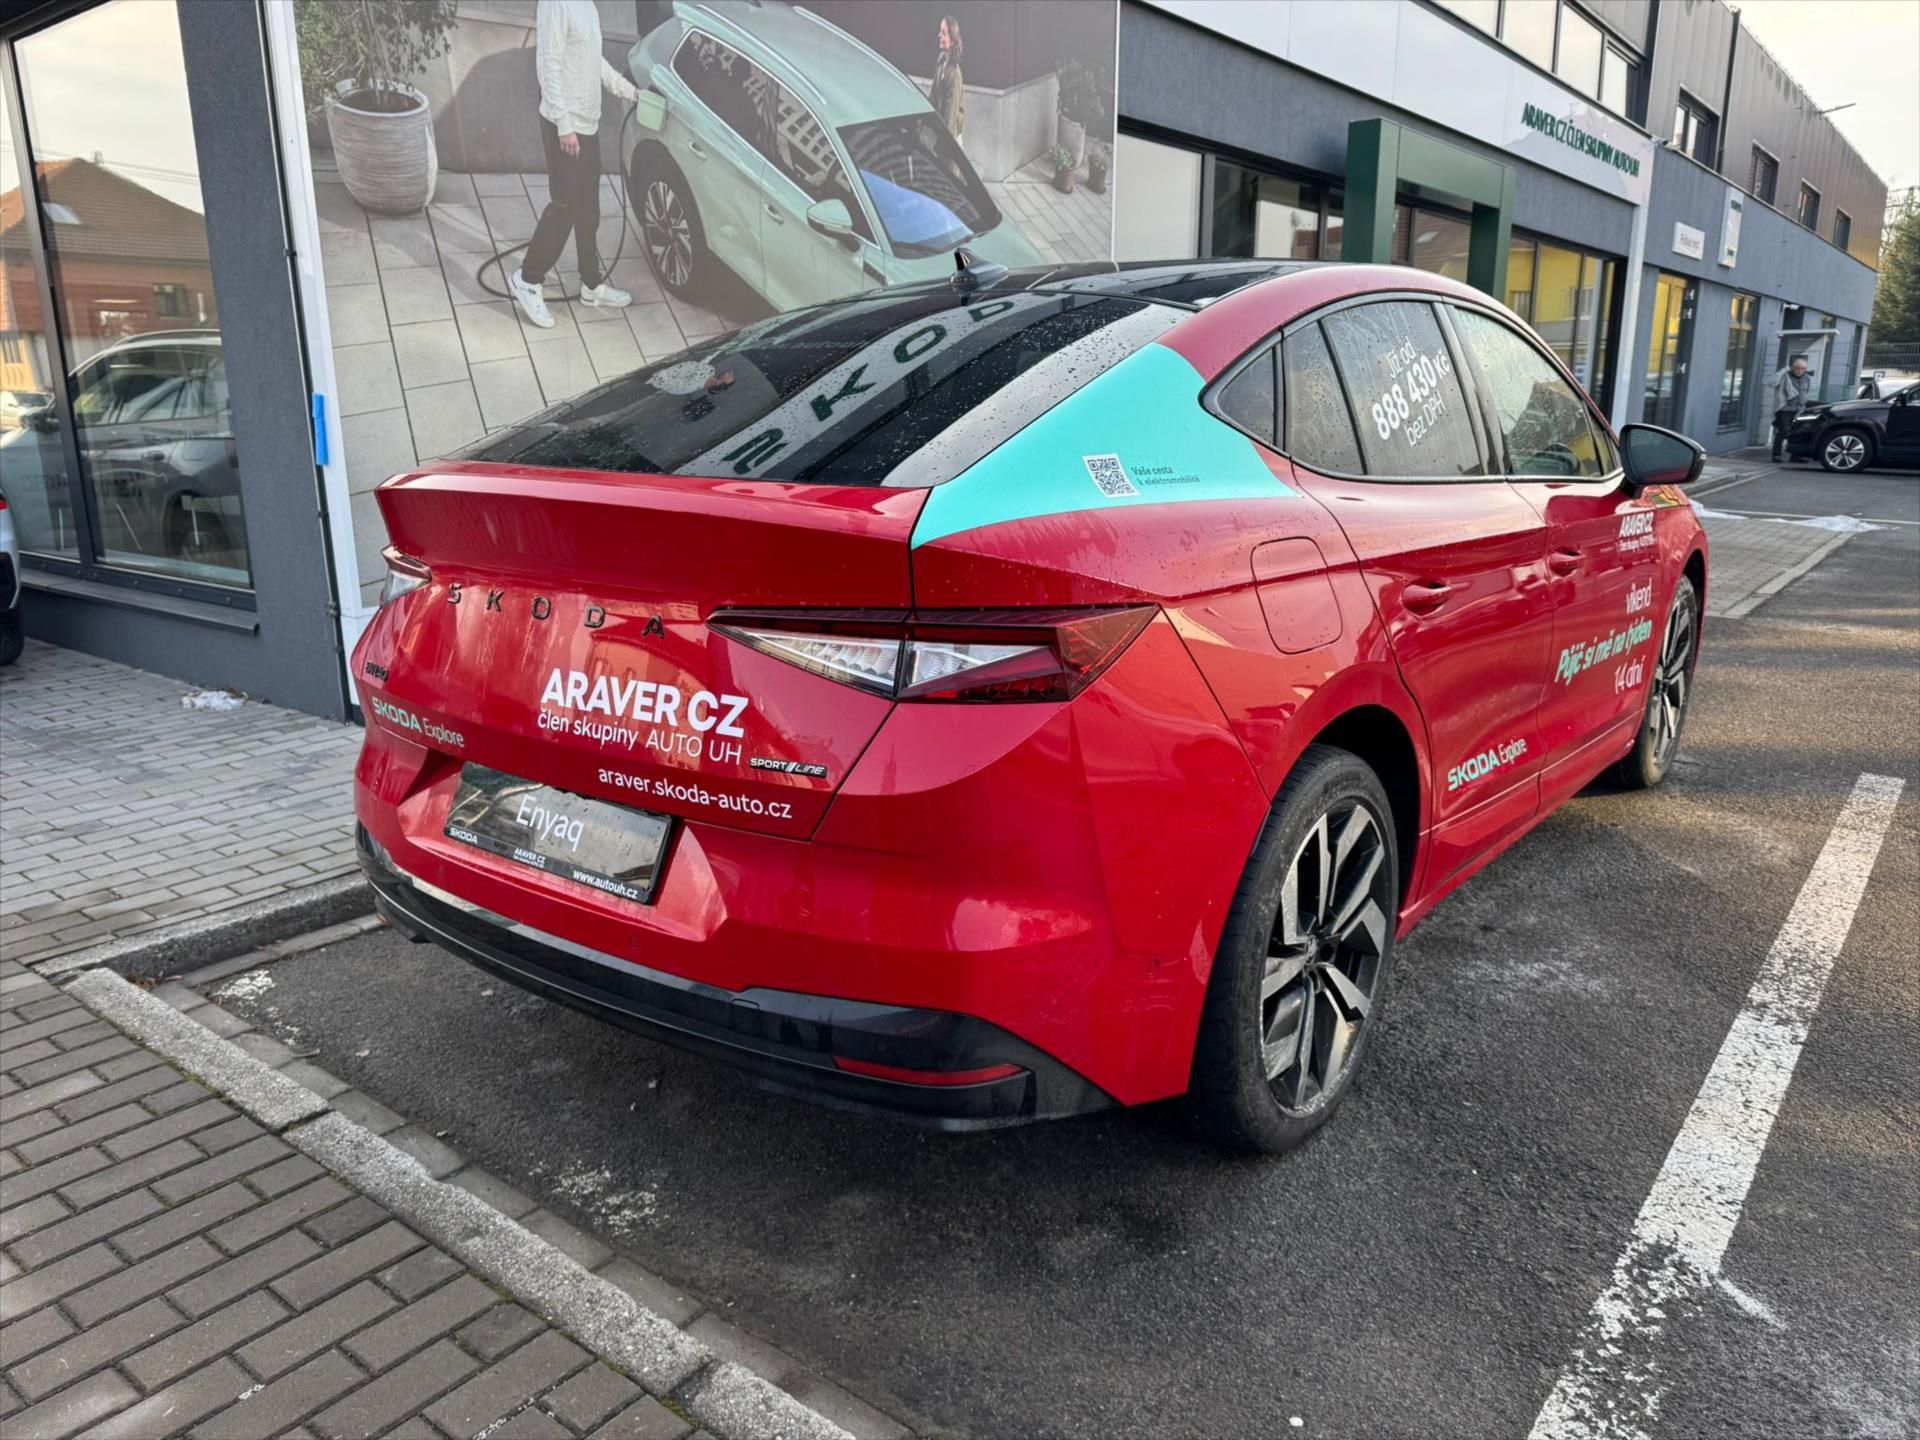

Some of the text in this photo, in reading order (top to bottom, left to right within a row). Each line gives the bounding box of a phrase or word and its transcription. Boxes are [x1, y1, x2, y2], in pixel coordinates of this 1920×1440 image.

[1521, 102, 1556, 138] ARAVER
[1555, 119, 1568, 144] CZ
[1400, 335, 1416, 365] od
[1372, 383, 1410, 440] 888
[1406, 354, 1437, 403] 430
[1403, 390, 1446, 448] bez DPH
[1152, 465, 1174, 475] cesta
[1554, 641, 1586, 686] Půjč
[1582, 636, 1598, 670] si
[1611, 632, 1627, 656] na
[1625, 616, 1652, 656] týden
[1614, 655, 1647, 694] 14 dní
[541, 668, 749, 738] ARAVER CZ
[422, 717, 465, 748] Explore
[537, 707, 742, 765] člen skupiny AUTO UH
[1498, 738, 1527, 765] Explore
[598, 768, 792, 819] araver.skoda-auto.cz
[516, 793, 585, 852] Enyaq
[513, 847, 537, 861] ARAVER
[536, 855, 547, 865] CZ
[573, 869, 639, 900] www.autouh.cz
